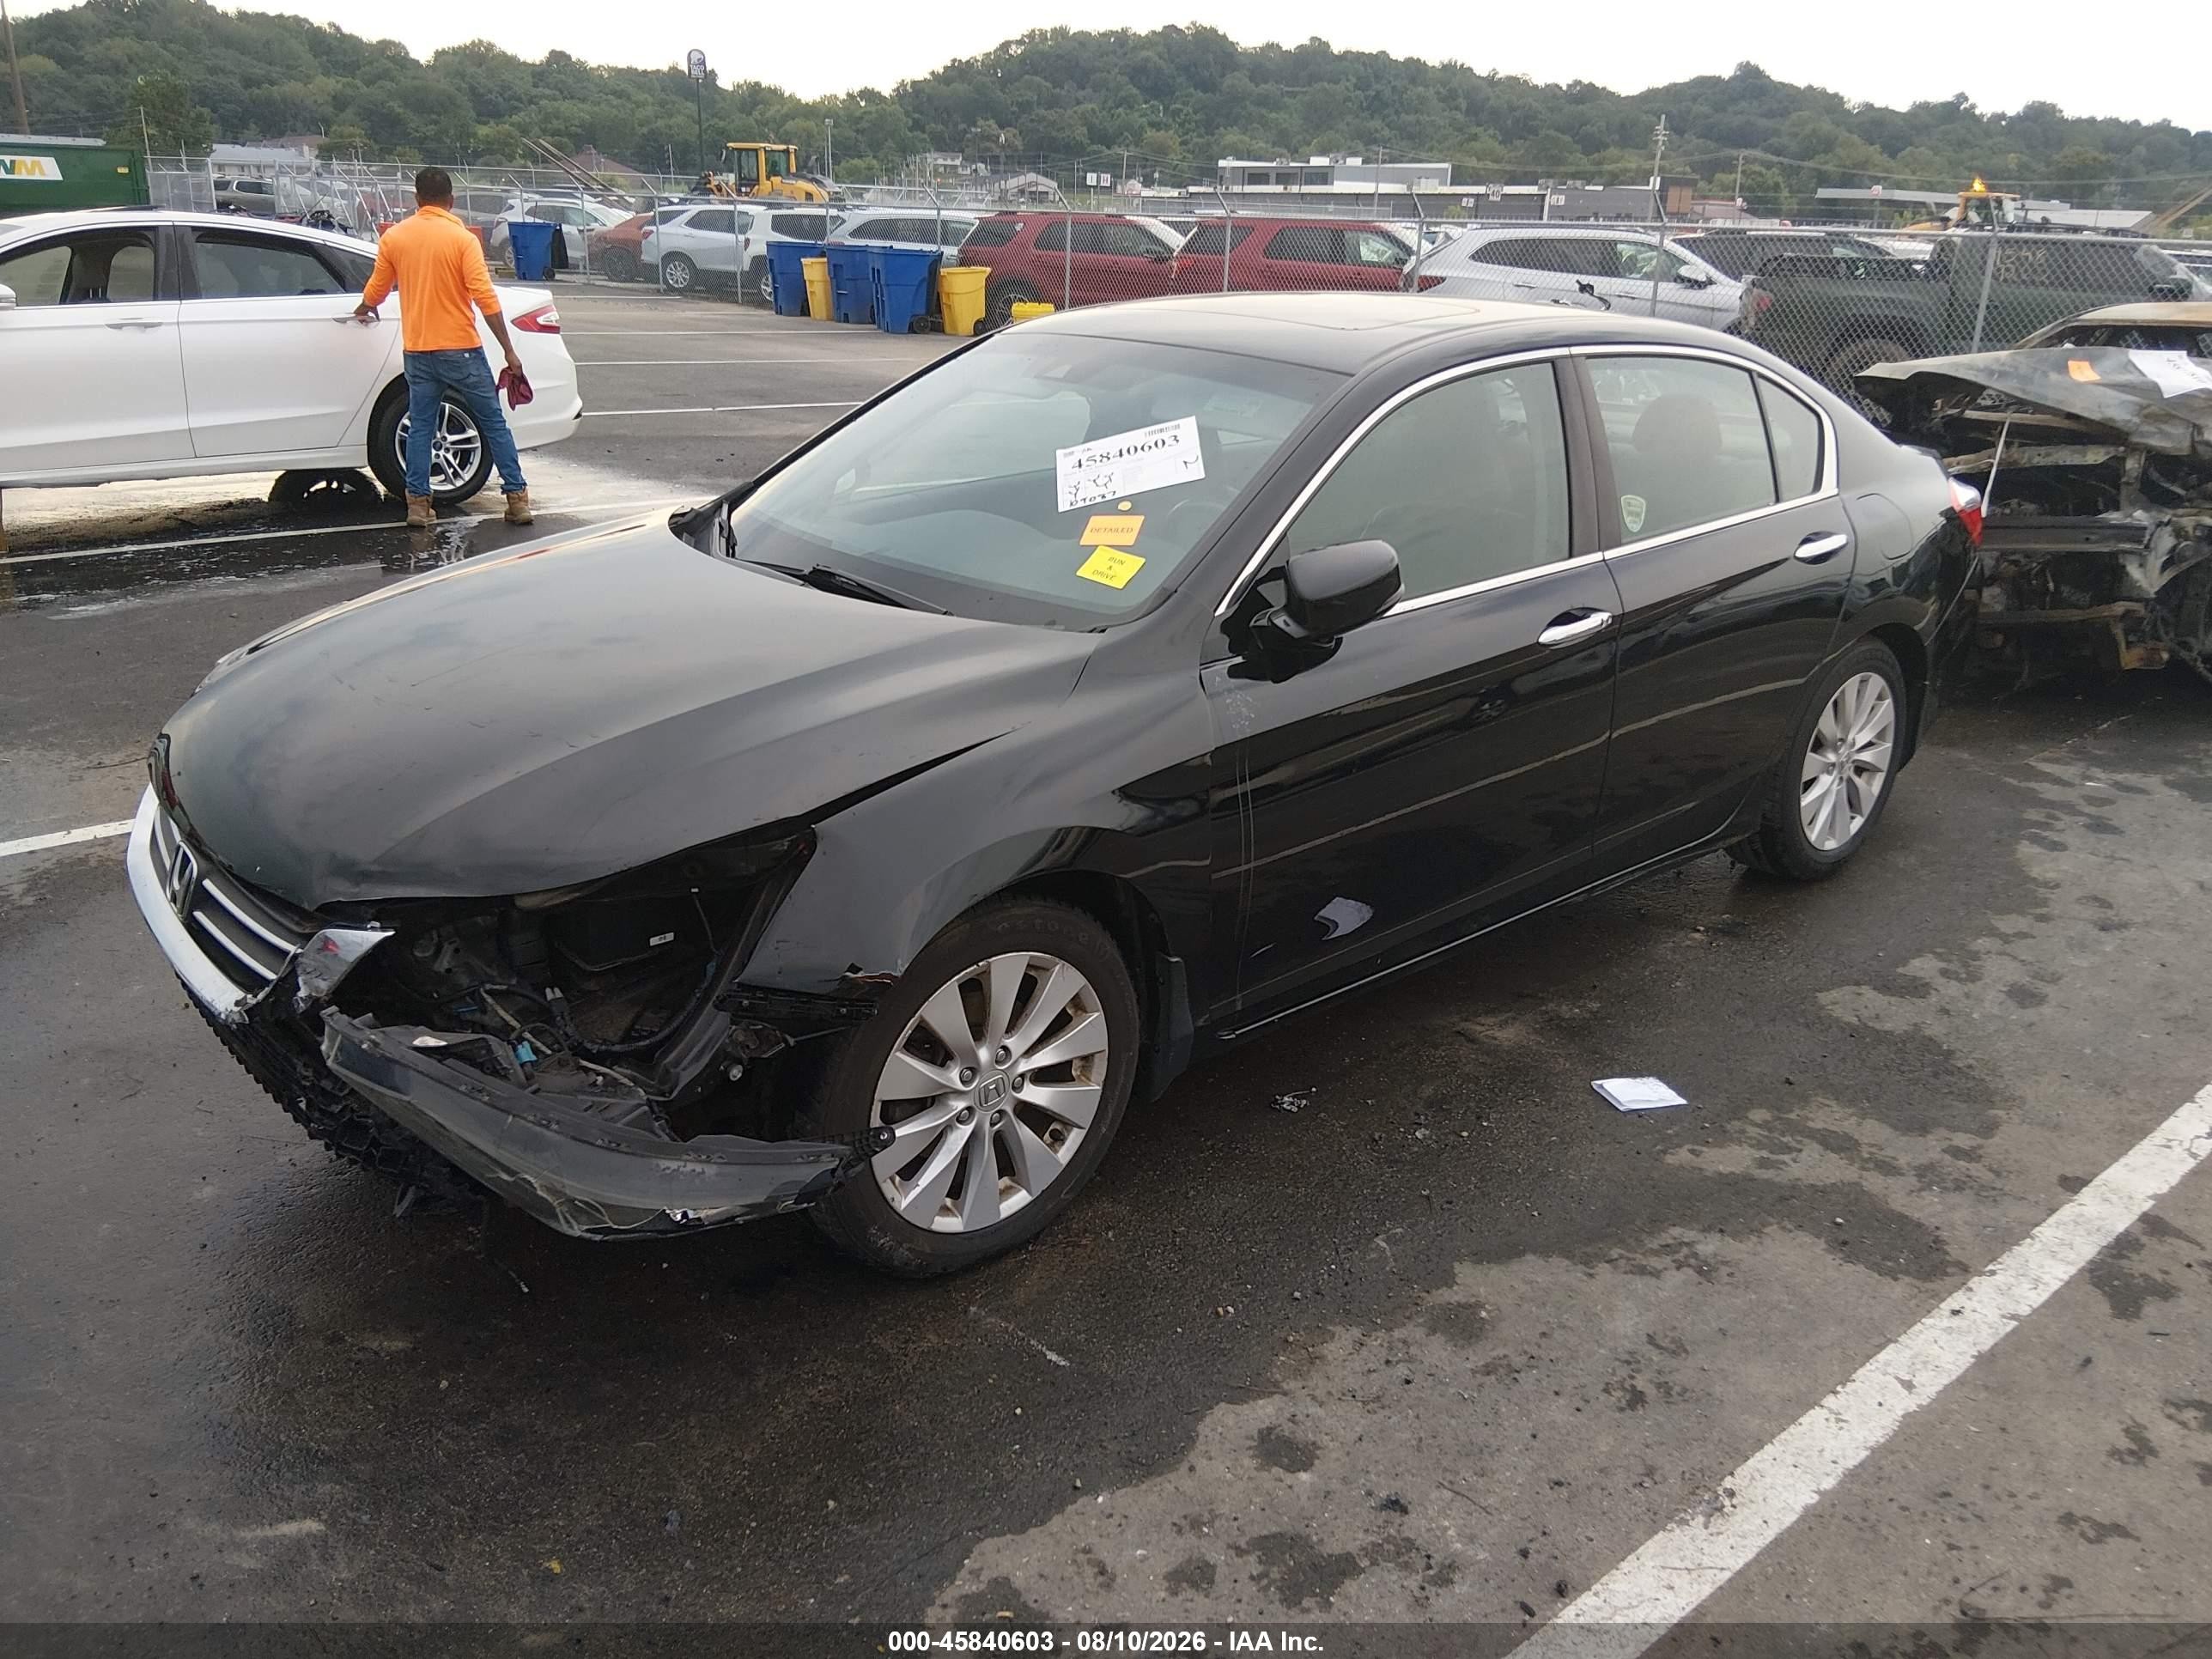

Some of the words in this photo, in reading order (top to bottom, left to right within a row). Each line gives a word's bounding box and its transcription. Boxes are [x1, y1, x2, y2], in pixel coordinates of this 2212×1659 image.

[1072, 434, 1180, 469] 45840603
[1108, 556, 1126, 565] RUN
[1092, 569, 1117, 581] DRIVE
